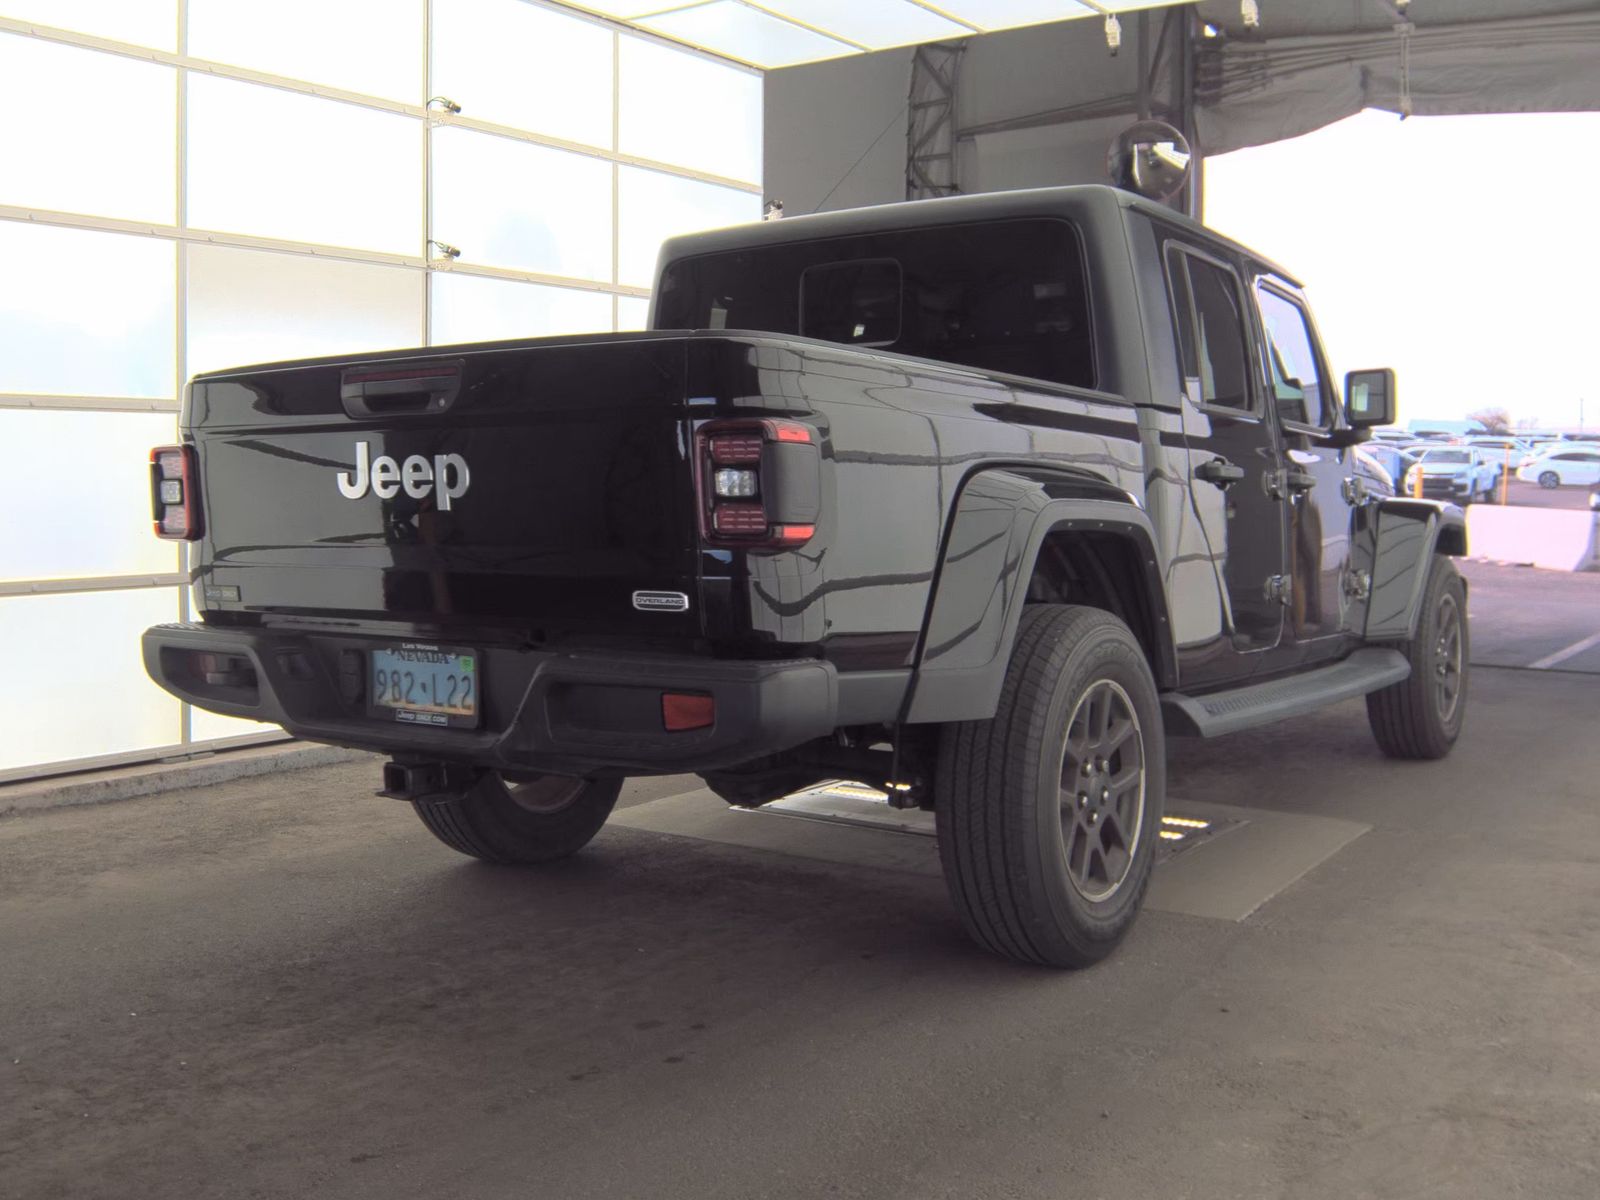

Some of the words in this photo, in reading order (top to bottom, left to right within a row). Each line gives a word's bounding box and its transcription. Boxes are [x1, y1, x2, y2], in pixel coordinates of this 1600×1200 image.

[336, 441, 470, 511] Jeep
[397, 650, 450, 664] NEVADA
[377, 669, 416, 704] 982
[432, 673, 473, 710] L22
